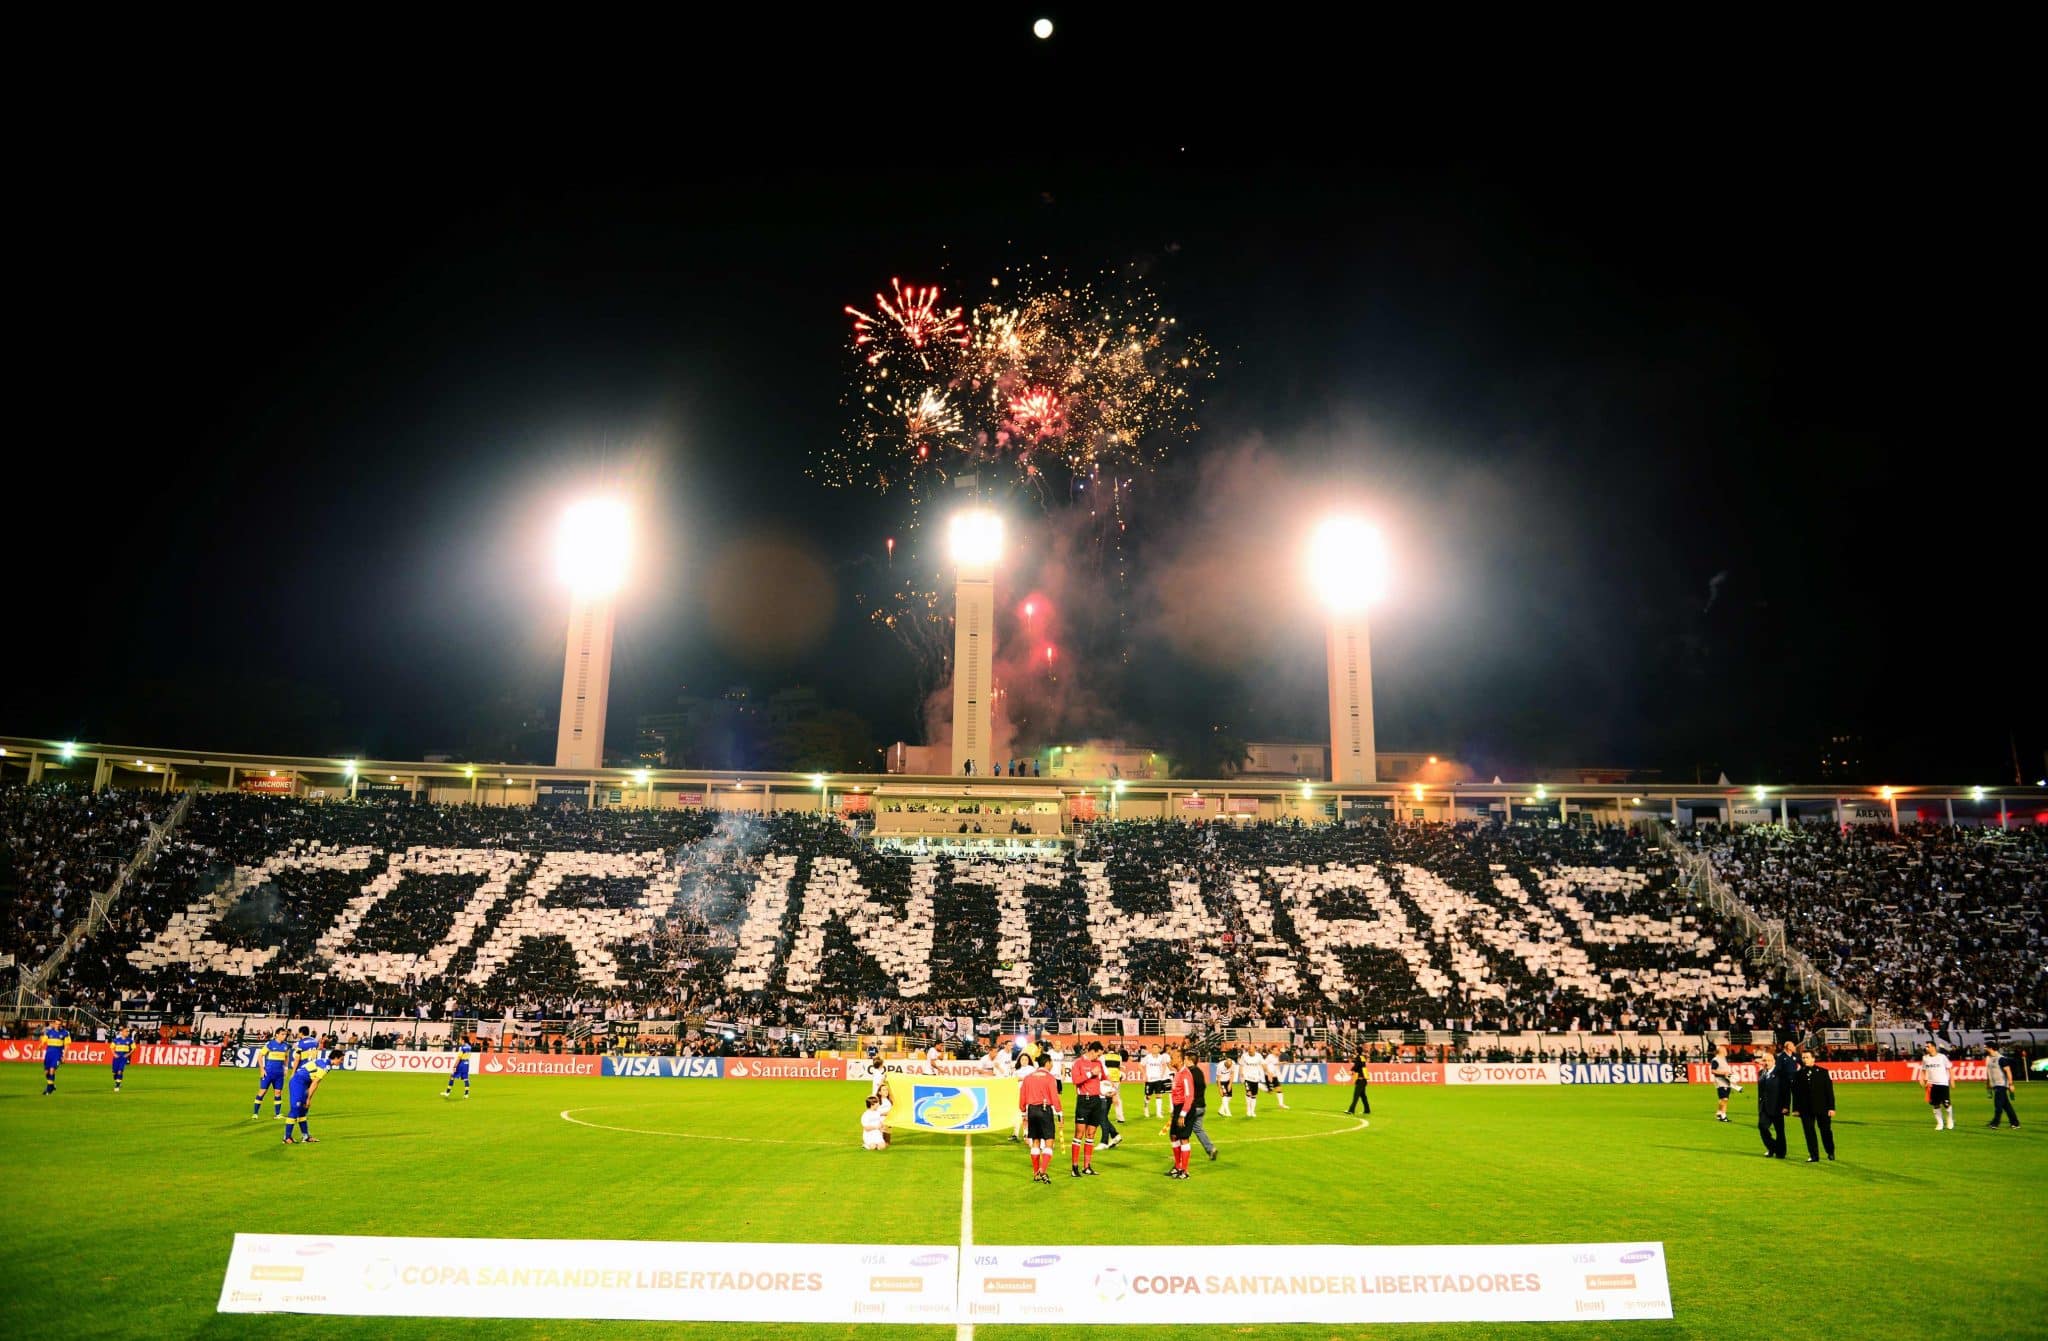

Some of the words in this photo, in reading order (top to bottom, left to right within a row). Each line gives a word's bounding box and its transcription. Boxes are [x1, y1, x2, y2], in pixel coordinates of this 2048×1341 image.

[254, 780, 292, 789] LANCHONET
[126, 838, 1772, 1003] CORINTHIANS
[153, 1046, 207, 1065] KAISER
[399, 1056, 456, 1070] TOYOT
[505, 1056, 594, 1074] Santander
[610, 1057, 661, 1076] VISA
[668, 1058, 718, 1077] VISA
[751, 1061, 839, 1078] Santander
[1484, 1068, 1547, 1080] TOYOTA
[1560, 1063, 1674, 1084] SAMSUNG
[861, 1255, 887, 1265] VISA
[974, 1255, 999, 1266] VISA
[1571, 1254, 1596, 1265] VISA
[400, 1264, 471, 1286] COPA
[475, 1265, 632, 1289] SANTANDER
[635, 1270, 824, 1291] LIBERTADORES
[1132, 1275, 1201, 1295] COPA
[1205, 1275, 1357, 1295] SANTANDER
[1360, 1273, 1541, 1294] LIBERTADORES
